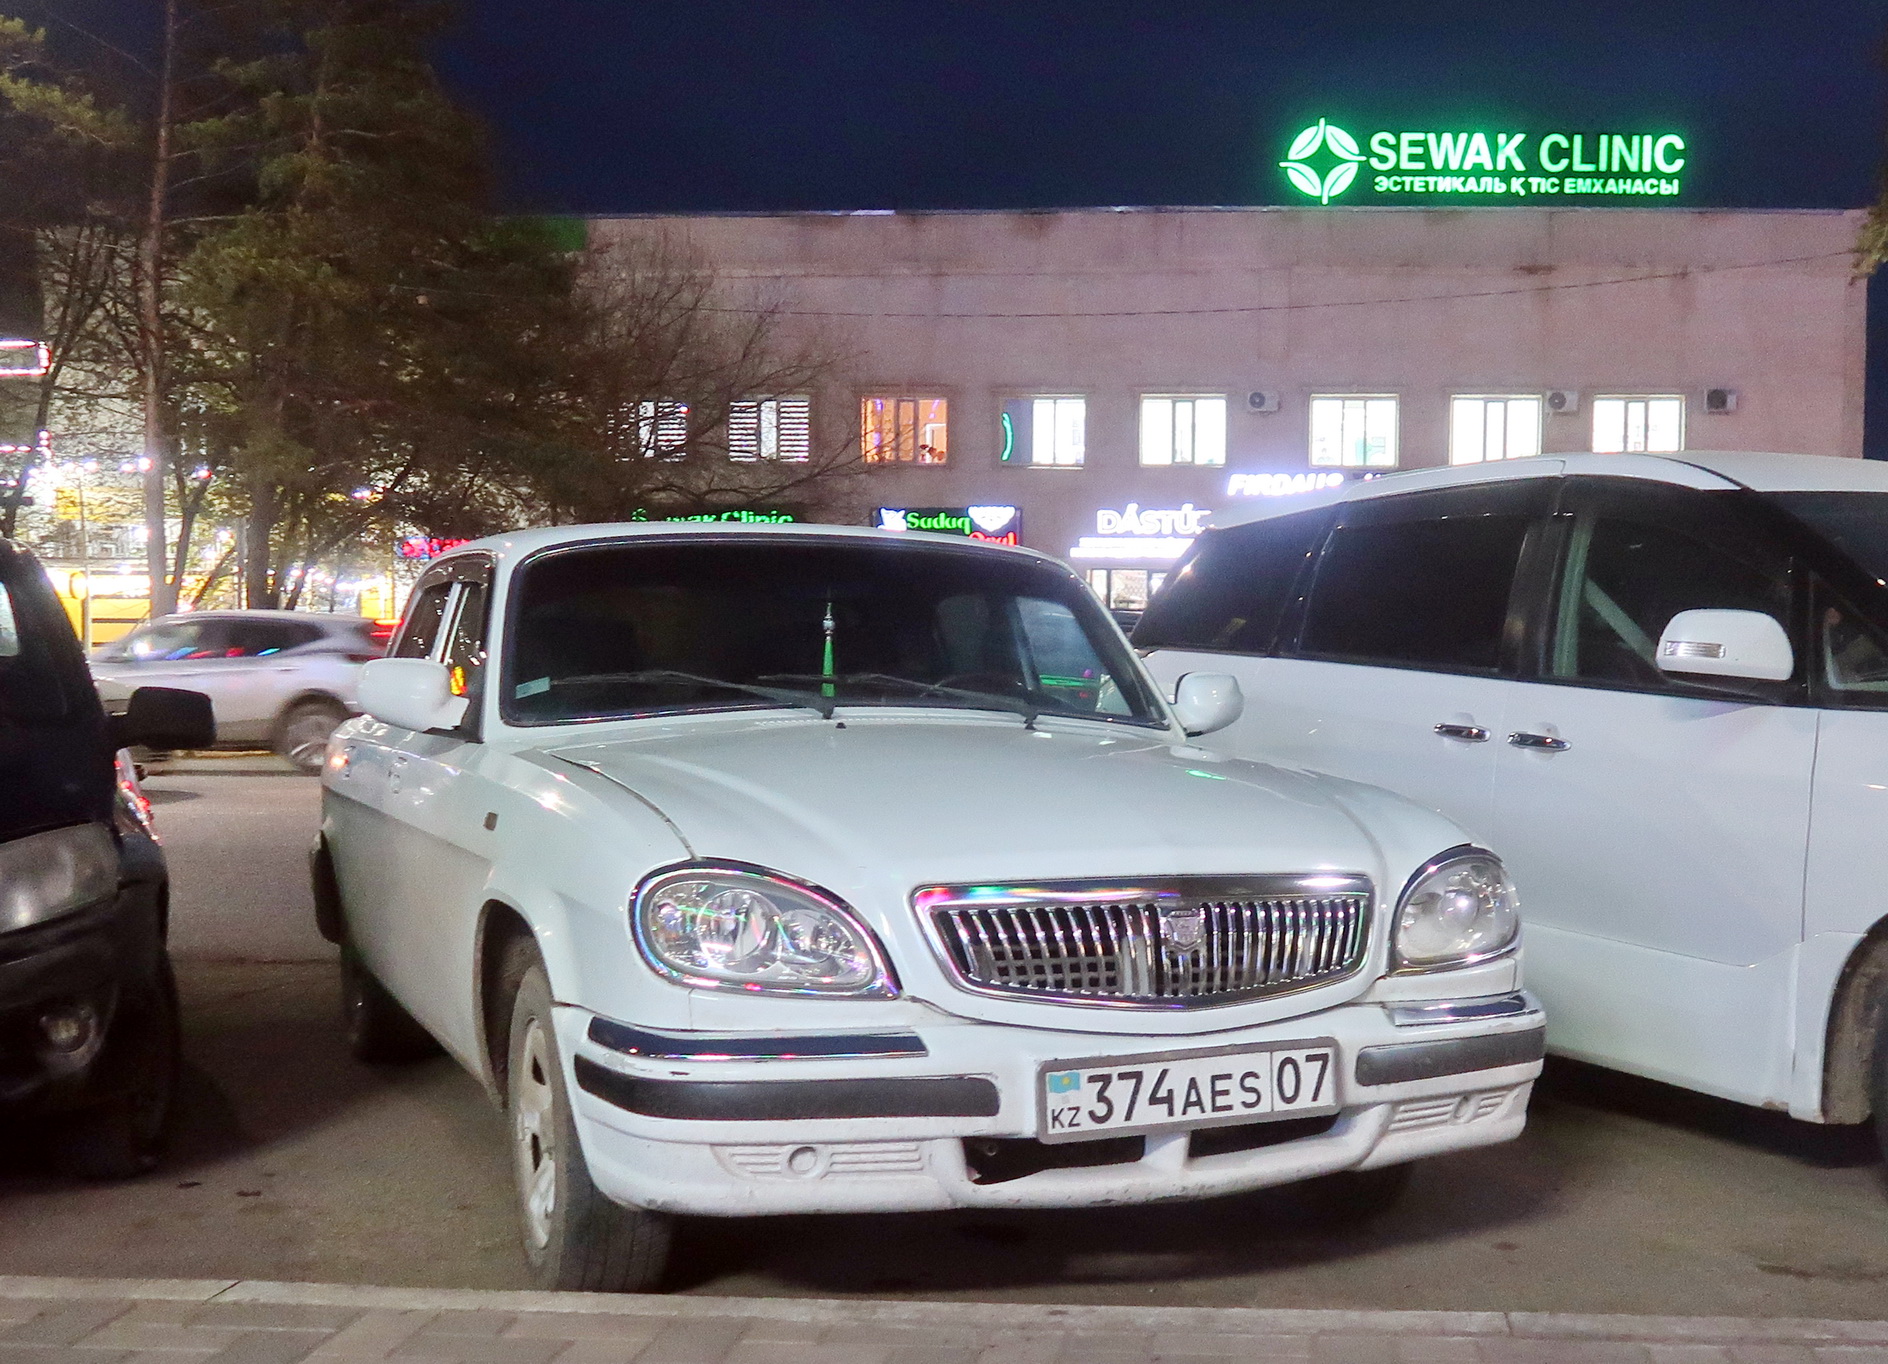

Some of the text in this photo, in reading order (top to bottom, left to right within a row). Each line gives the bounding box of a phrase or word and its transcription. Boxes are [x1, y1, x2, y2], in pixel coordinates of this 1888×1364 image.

[1369, 131, 1686, 175] SEWAK CLINIC
[1563, 177, 1680, 195] ЕМХАНАСЫ
[1276, 1053, 1330, 1105] 07
[1051, 1106, 1082, 1129] KZ
